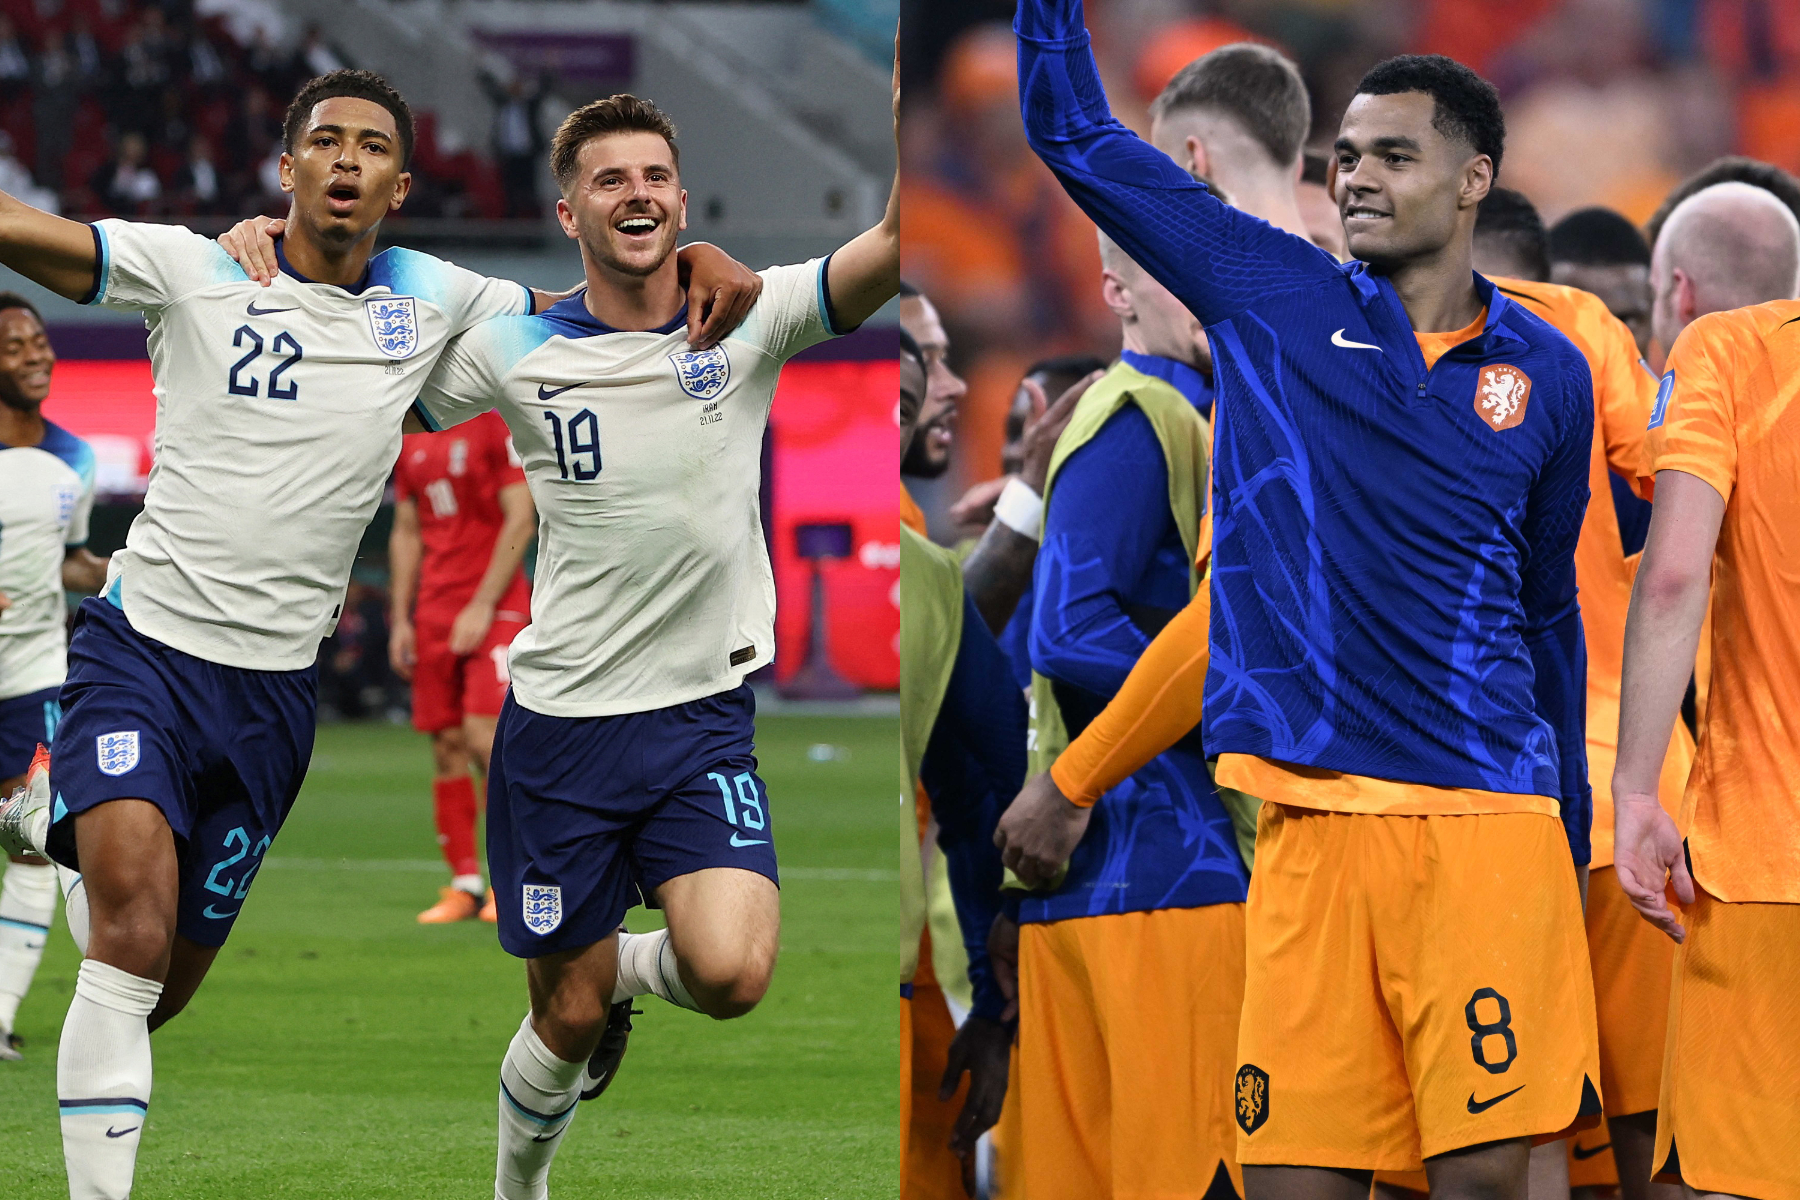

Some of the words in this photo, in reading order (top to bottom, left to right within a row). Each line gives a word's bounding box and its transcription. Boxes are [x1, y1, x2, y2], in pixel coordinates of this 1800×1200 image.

[228, 324, 303, 401] 22
[544, 408, 603, 481] 19
[699, 412, 722, 425] 21.11.22
[706, 771, 765, 831] 19
[1464, 986, 1518, 1075] 8
